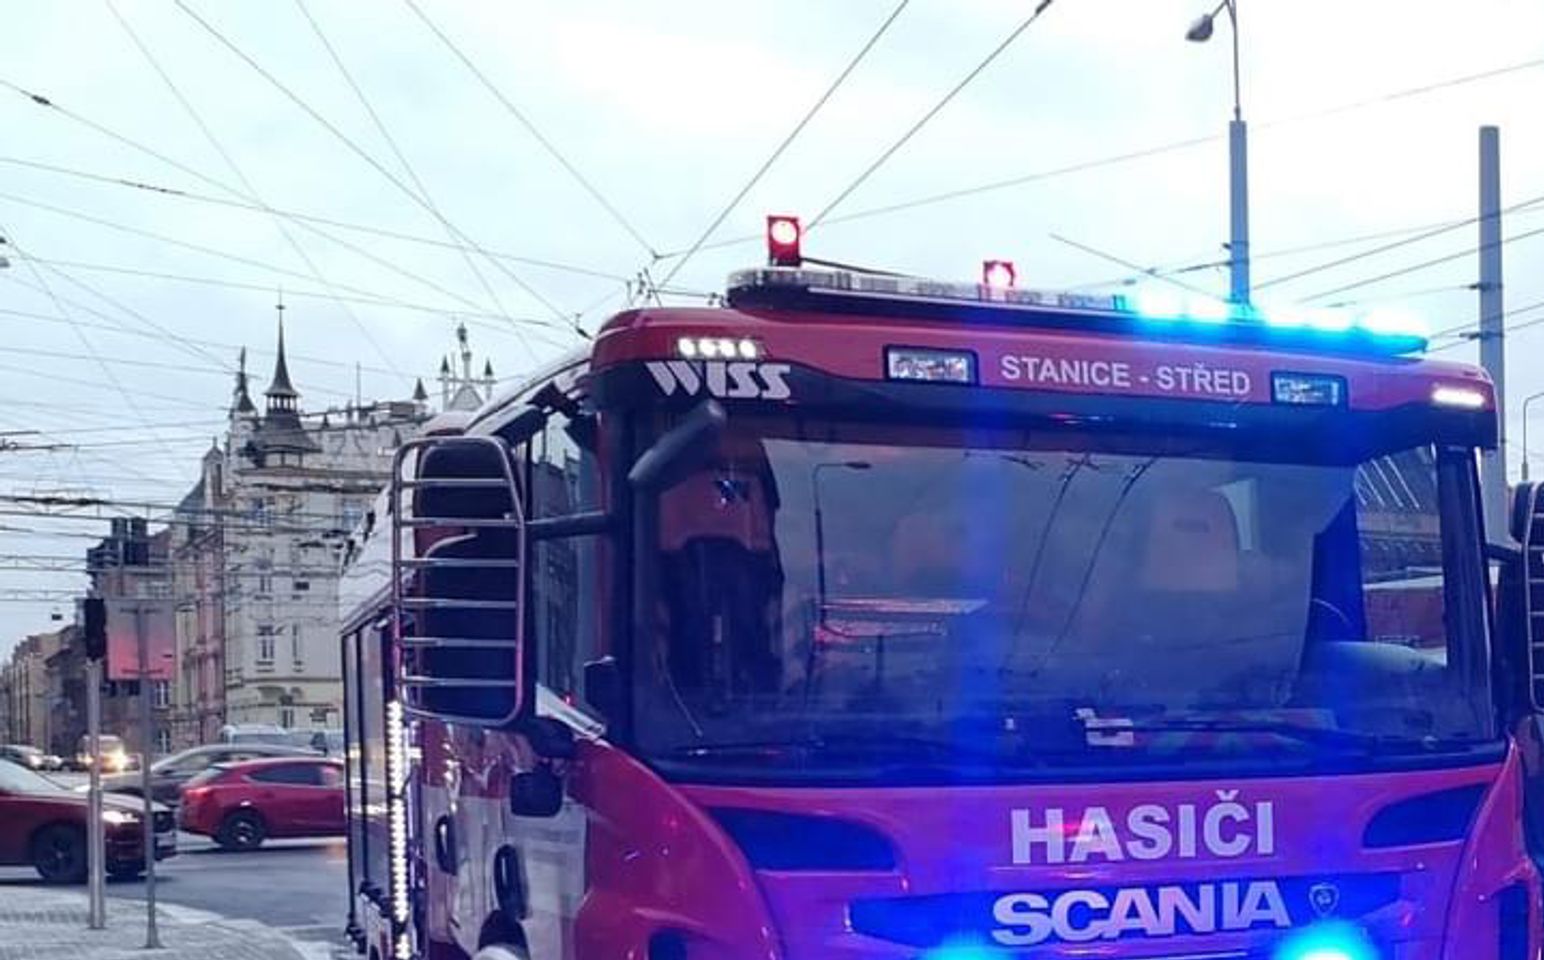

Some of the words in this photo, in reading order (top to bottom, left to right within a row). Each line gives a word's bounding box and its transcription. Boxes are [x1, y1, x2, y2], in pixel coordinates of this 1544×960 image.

[645, 360, 791, 399] WISS
[1001, 355, 1131, 388] STANICE
[1156, 362, 1251, 396] STŘED
[1010, 789, 1274, 864] HASIČI
[992, 880, 1292, 946] SCANIA
